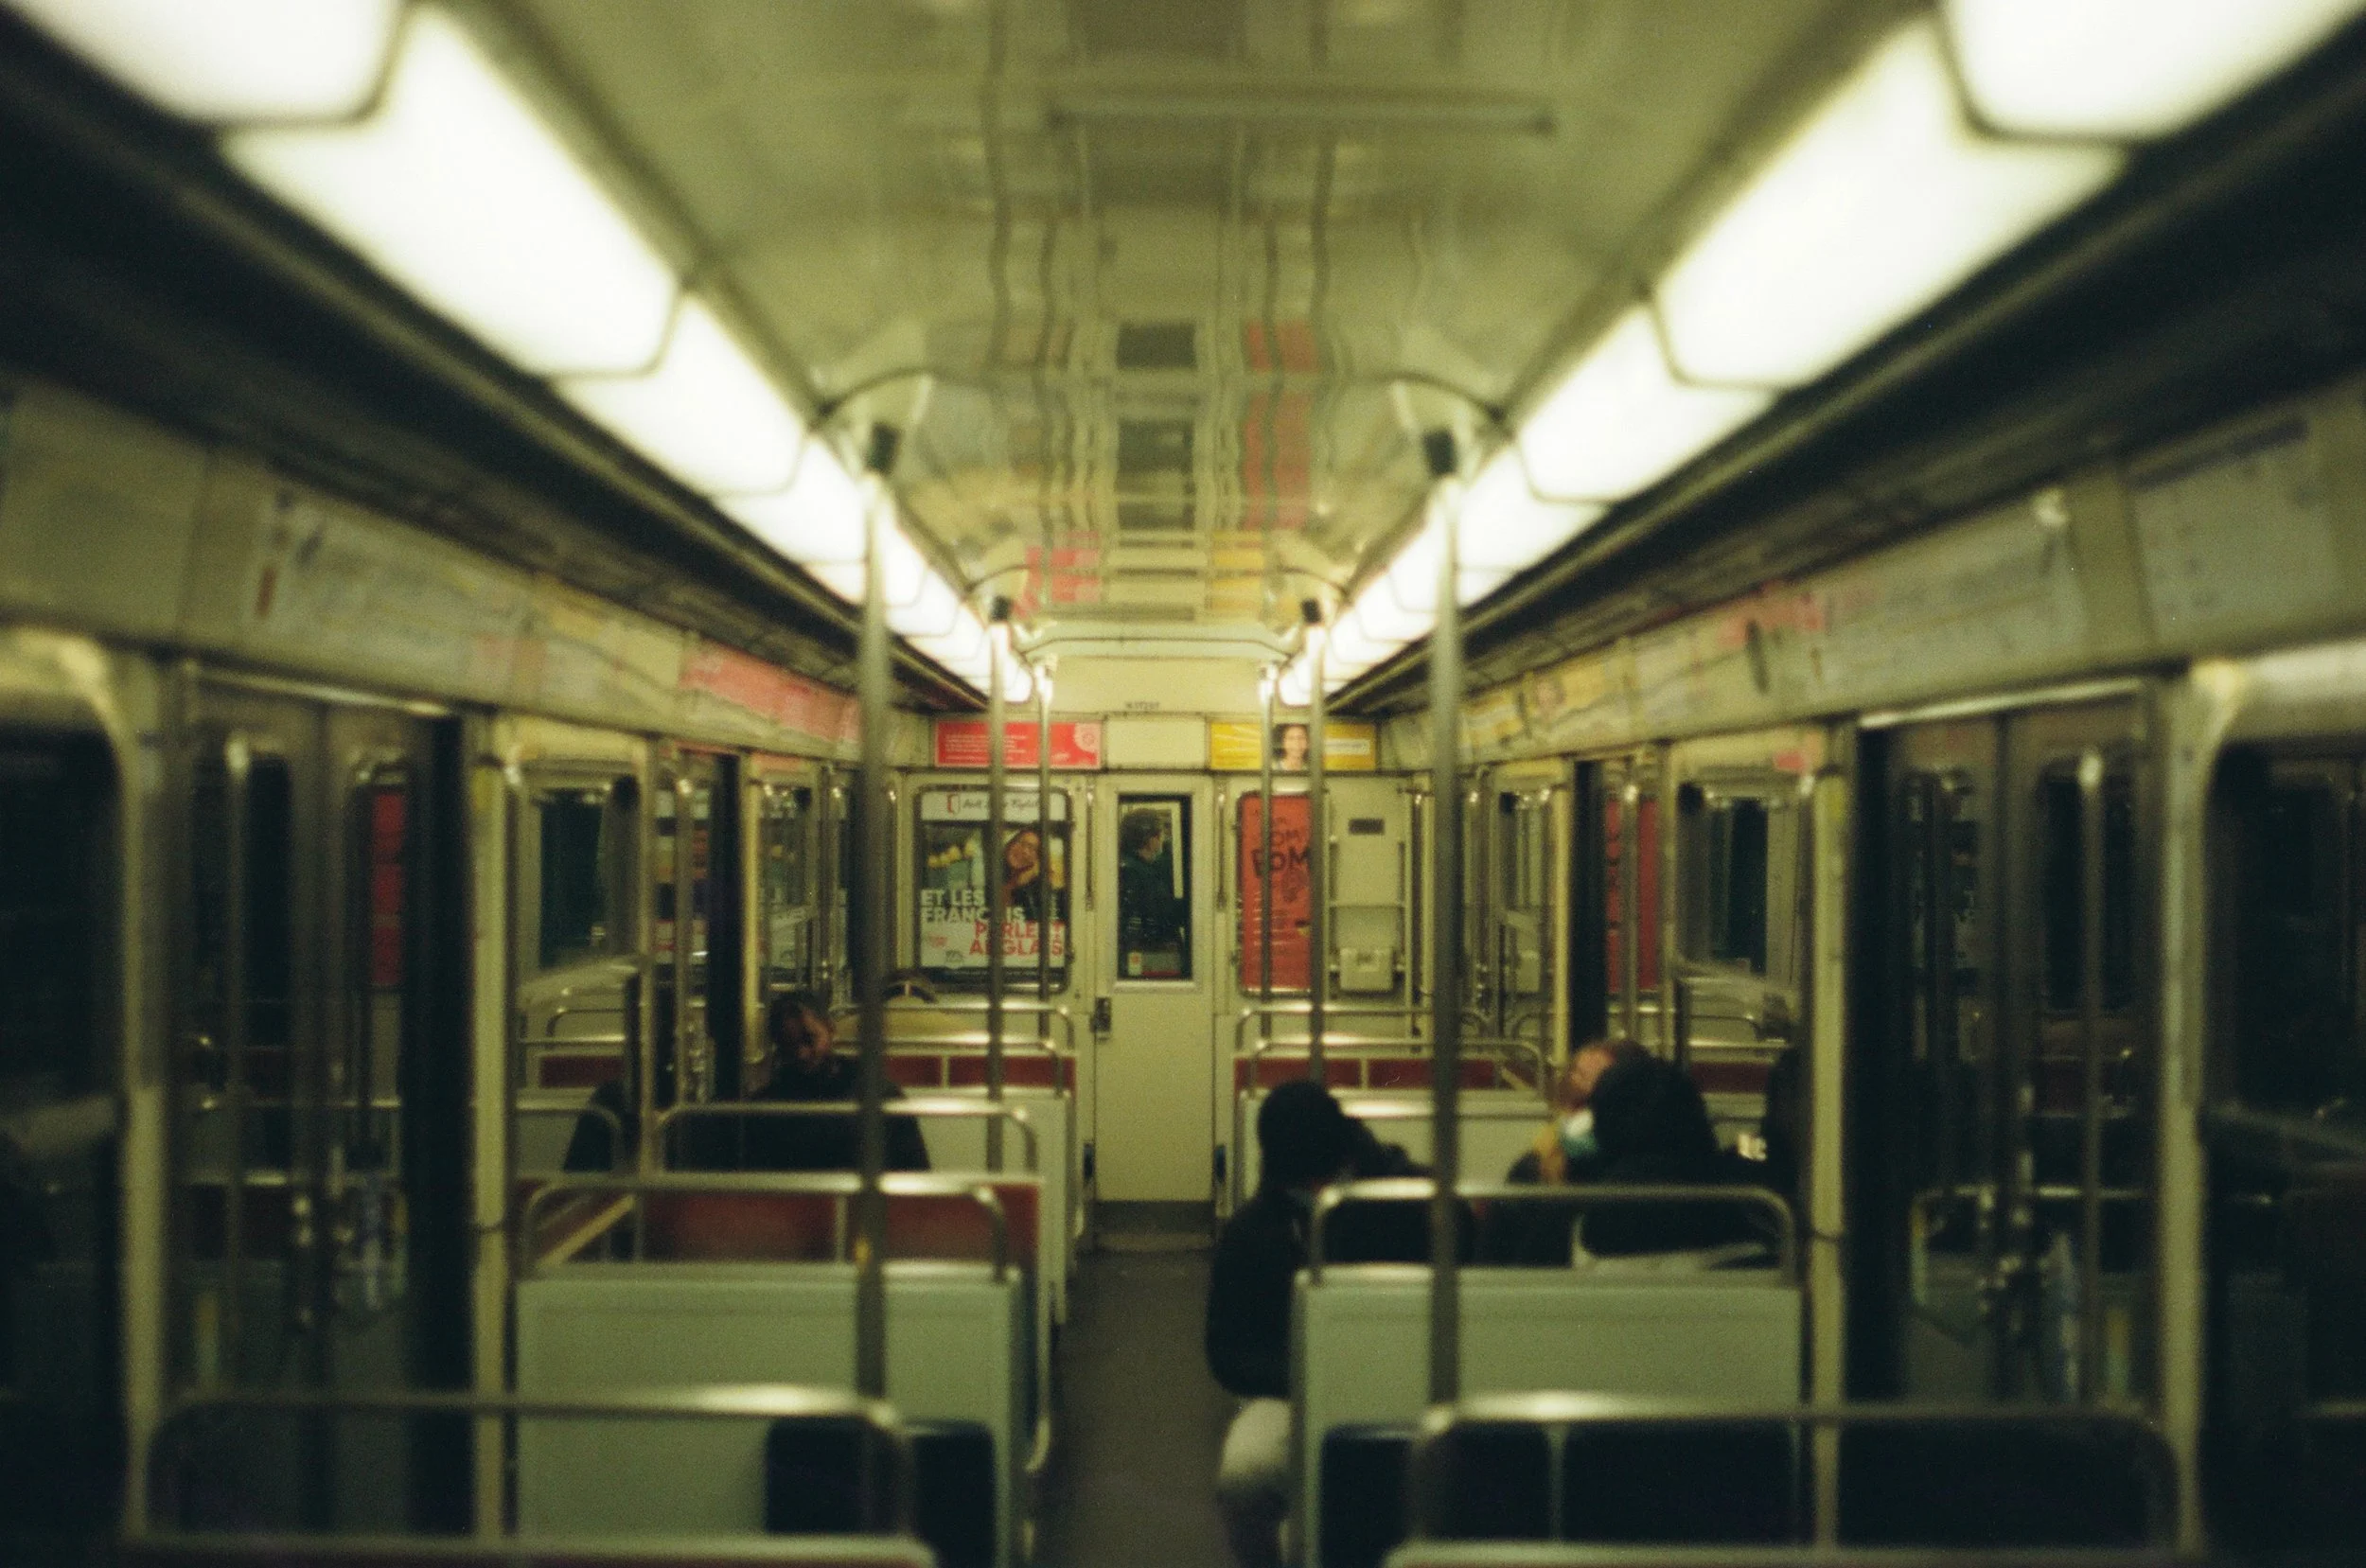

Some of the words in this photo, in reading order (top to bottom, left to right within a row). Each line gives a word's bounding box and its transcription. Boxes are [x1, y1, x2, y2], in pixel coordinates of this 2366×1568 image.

[921, 889, 945, 906] ET
[951, 889, 986, 906] LES
[975, 920, 1066, 938] PRLET
[969, 939, 1065, 956] AGLAS
